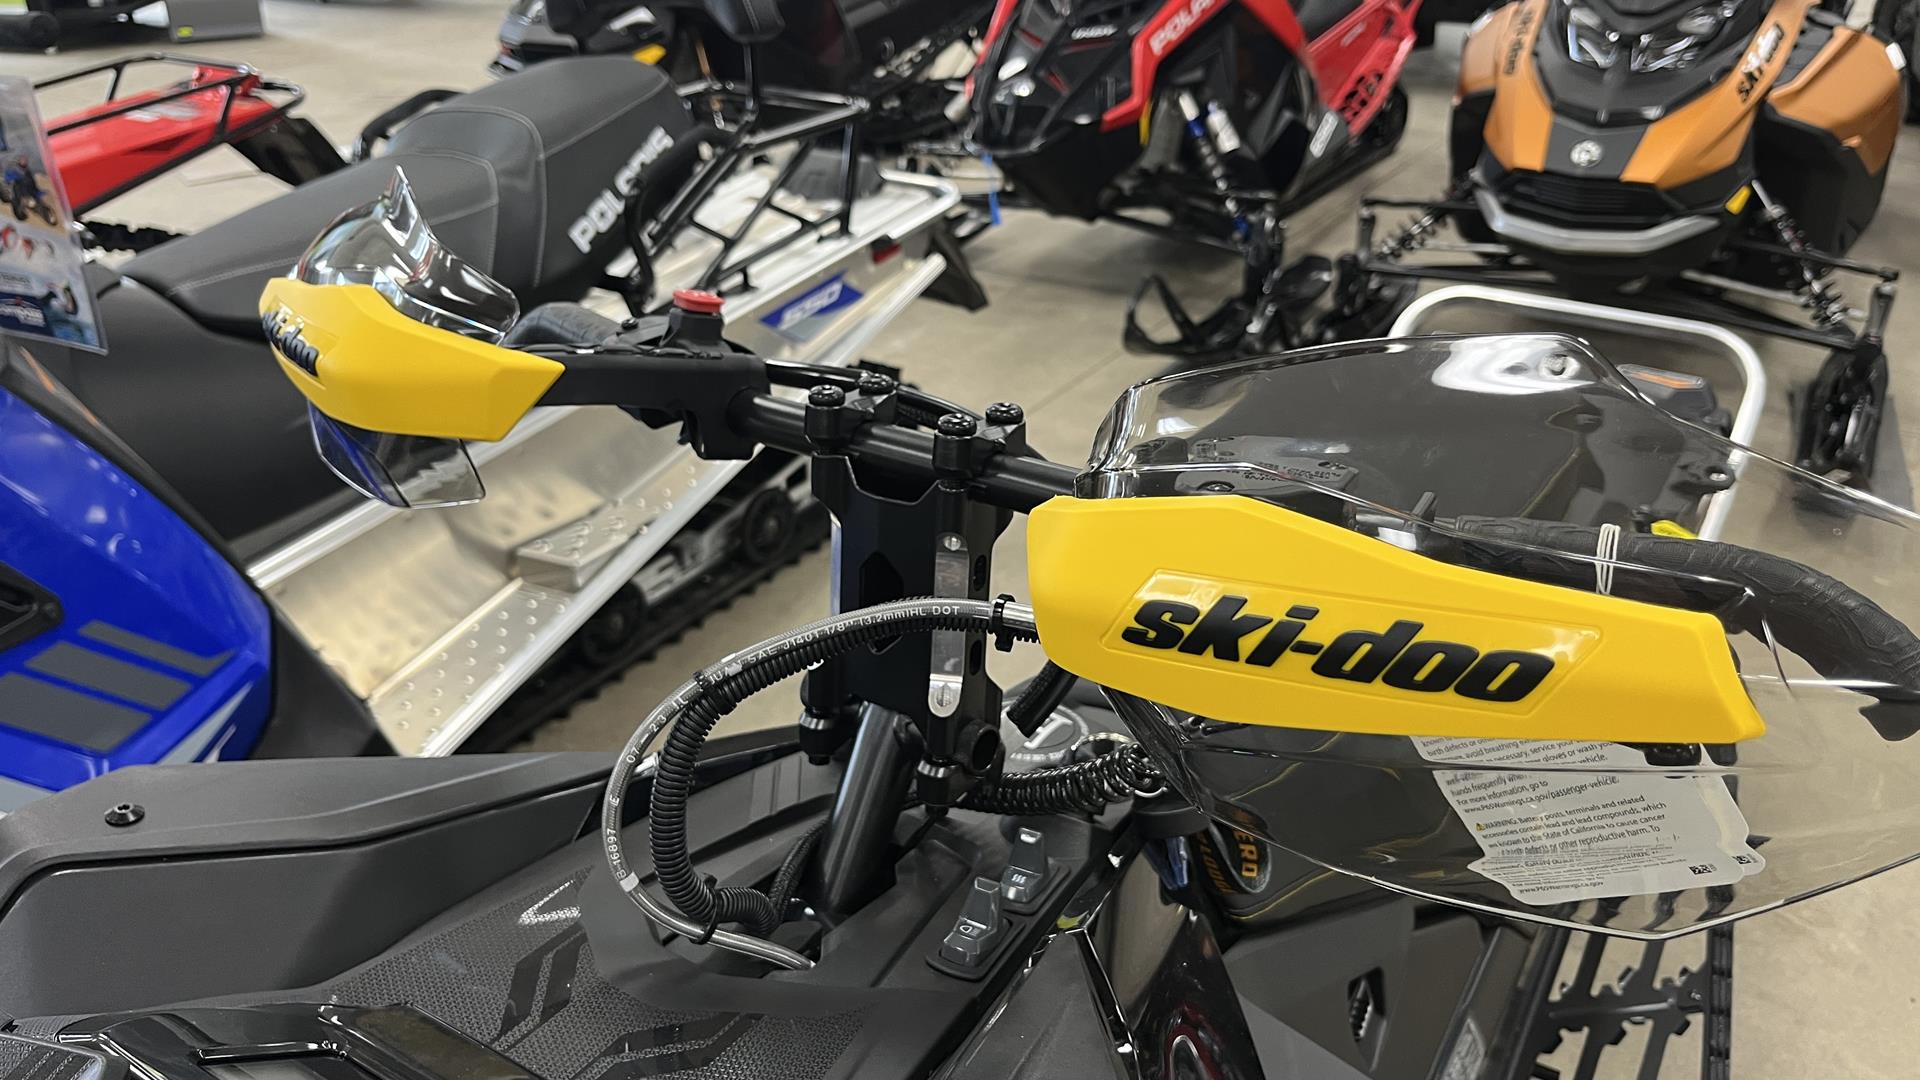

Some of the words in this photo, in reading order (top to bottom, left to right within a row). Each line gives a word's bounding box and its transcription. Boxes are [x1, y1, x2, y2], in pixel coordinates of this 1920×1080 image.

[747, 646, 778, 665] SAE
[783, 630, 821, 651] J1401
[932, 605, 960, 617] DOT
[1121, 594, 1555, 703] ski-doo
[1484, 741, 1519, 755] breathing
[1530, 743, 1556, 754] service
[1576, 743, 1598, 754] wash
[1529, 783, 1540, 793] go
[1539, 780, 1549, 788] to
[1561, 818, 1576, 828] and
[1576, 816, 1592, 826] lead
[1640, 801, 1667, 813] which
[1565, 803, 1601, 816] terminals
[1601, 800, 1617, 810] and
[1617, 795, 1645, 807] related
[1522, 836, 1531, 845] to
[1542, 830, 1562, 841] State
[1562, 828, 1570, 837] of
[1570, 823, 1605, 836] California
[1605, 821, 1615, 830] to
[1615, 817, 1639, 828] cause
[1639, 814, 1665, 825] cancer
[1558, 838, 1579, 850] other
[1578, 829, 1627, 847] reproductive
[1626, 827, 1651, 838] harm.
[1650, 824, 1661, 834] To
